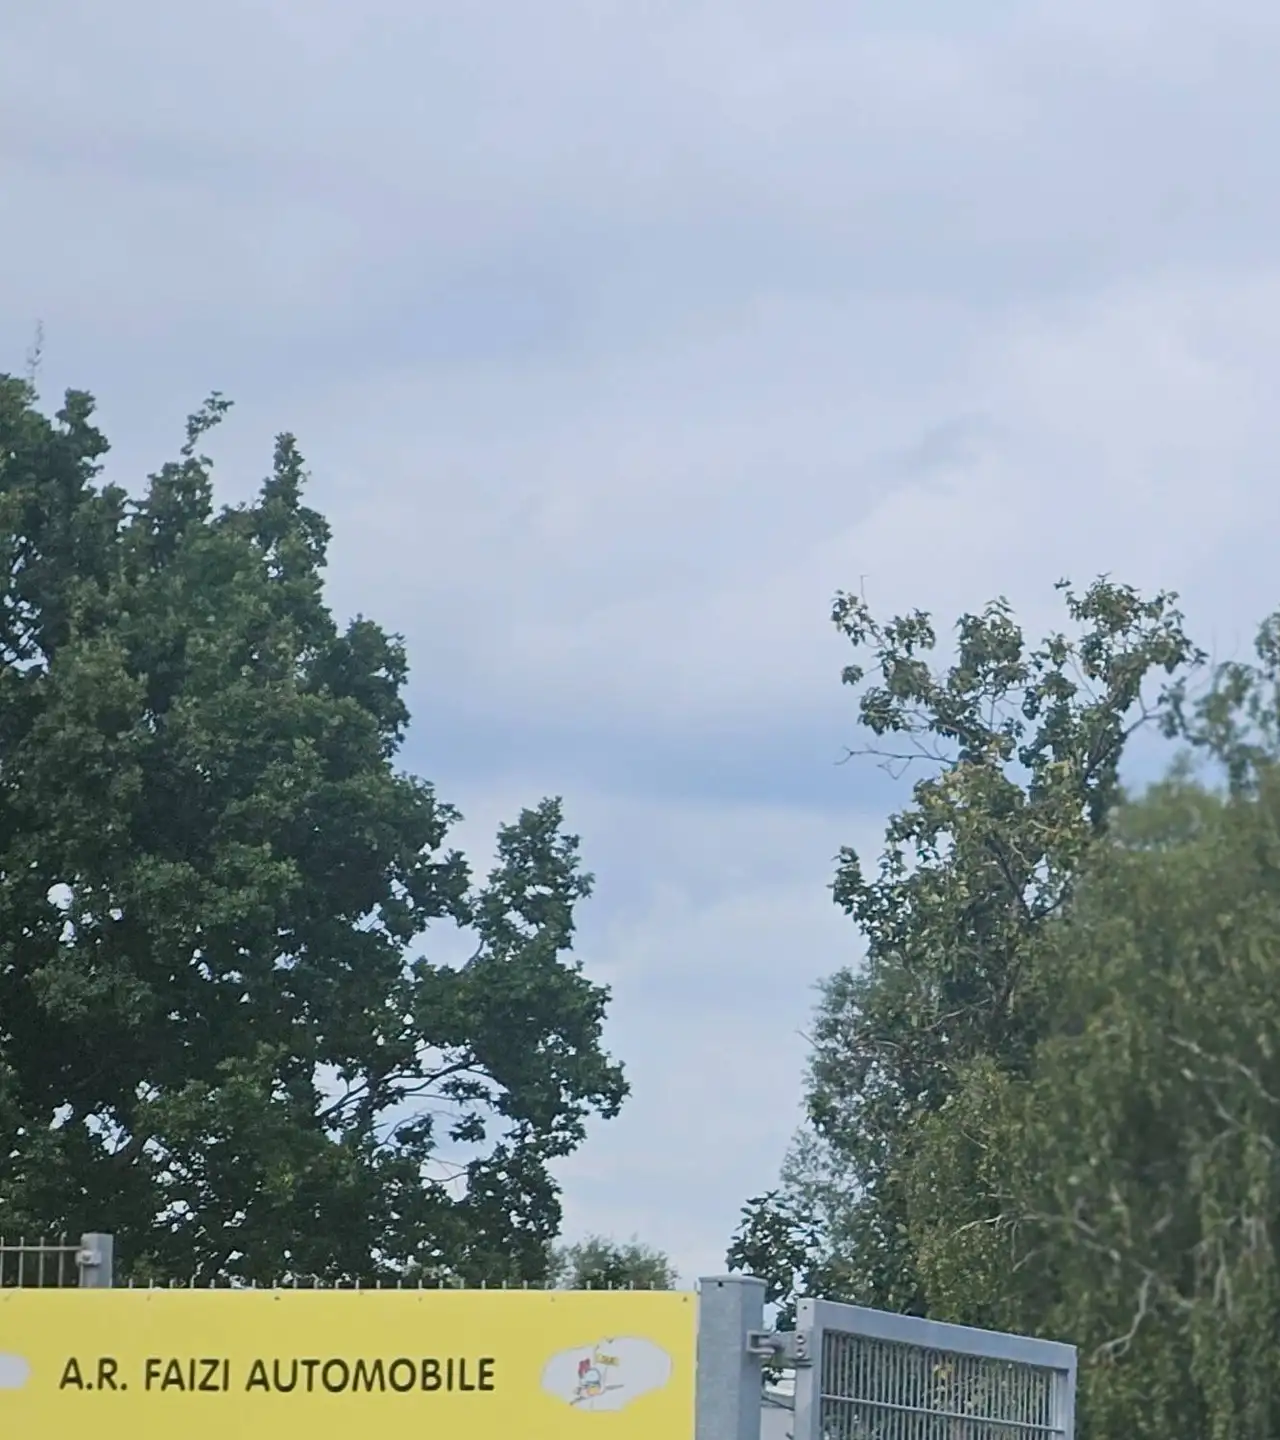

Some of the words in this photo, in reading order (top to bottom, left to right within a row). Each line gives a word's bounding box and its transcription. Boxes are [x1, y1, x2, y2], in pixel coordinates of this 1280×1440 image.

[60, 1357, 128, 1391] A.R.
[146, 1358, 230, 1392] FAIZI
[246, 1358, 495, 1393] AUTOMOBILE
